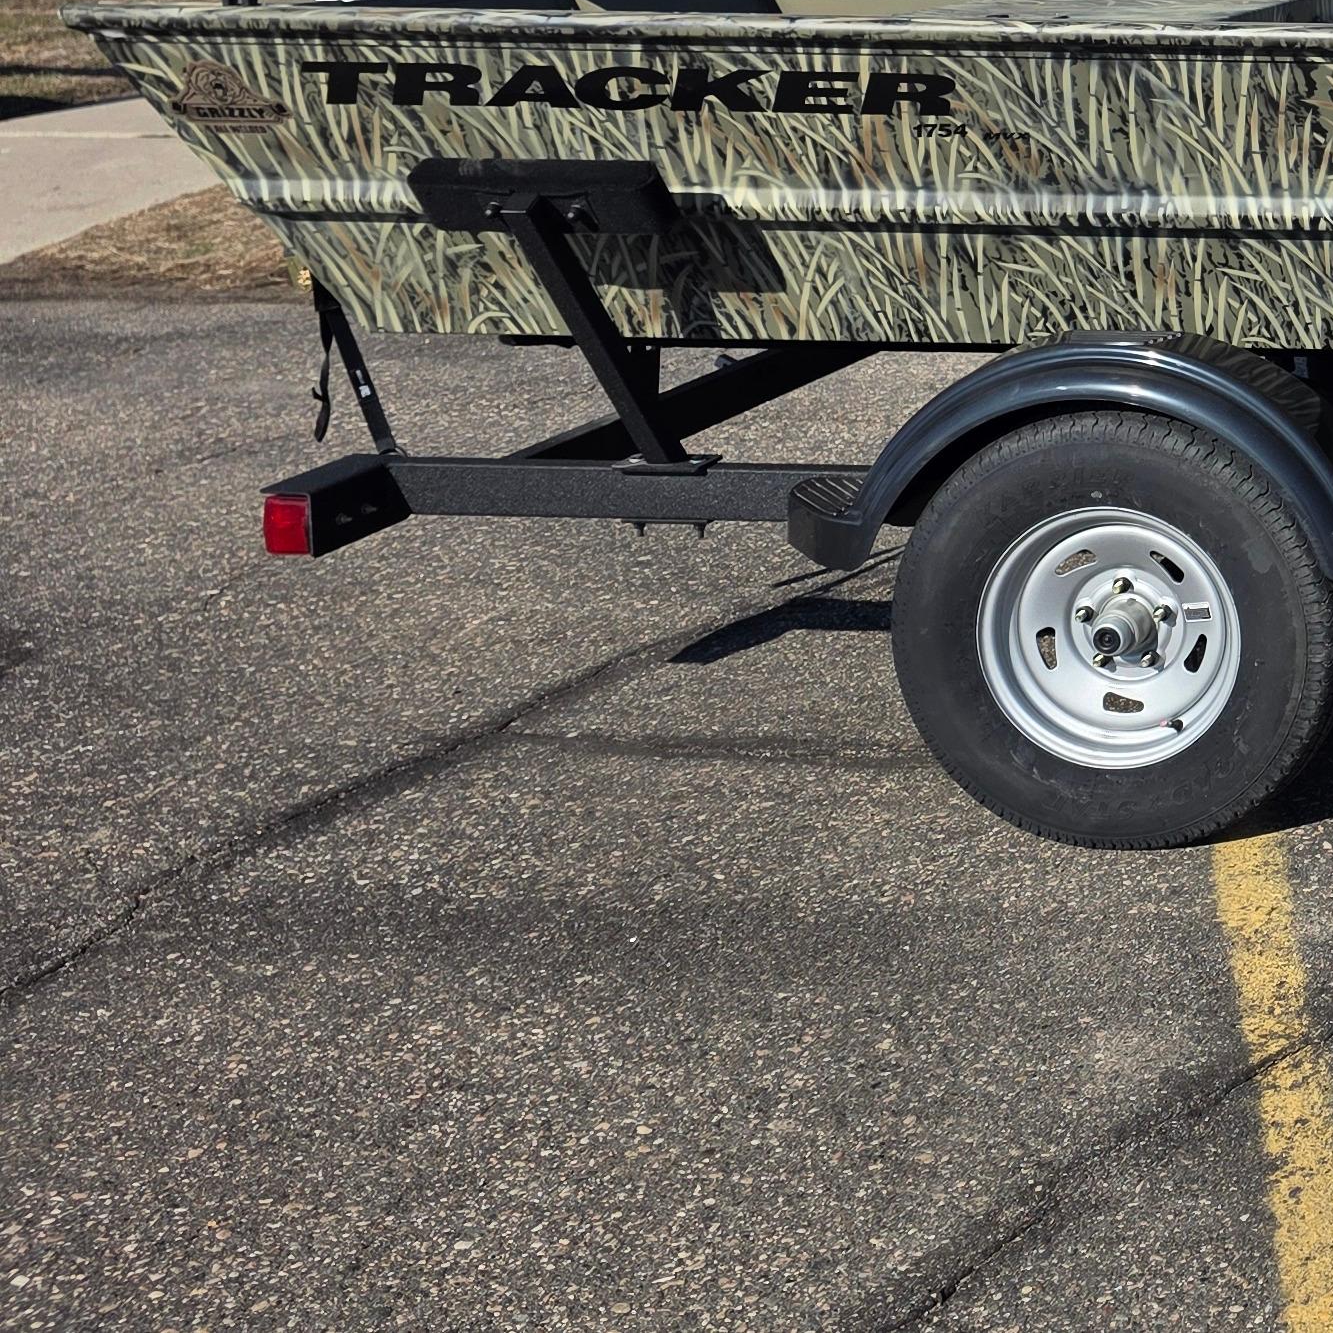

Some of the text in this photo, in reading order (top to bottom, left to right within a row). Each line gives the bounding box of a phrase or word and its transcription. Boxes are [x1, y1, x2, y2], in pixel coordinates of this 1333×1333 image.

[301, 61, 957, 118] TRACKER
[196, 107, 265, 118] GRIZZLY
[913, 124, 968, 138] 1754
